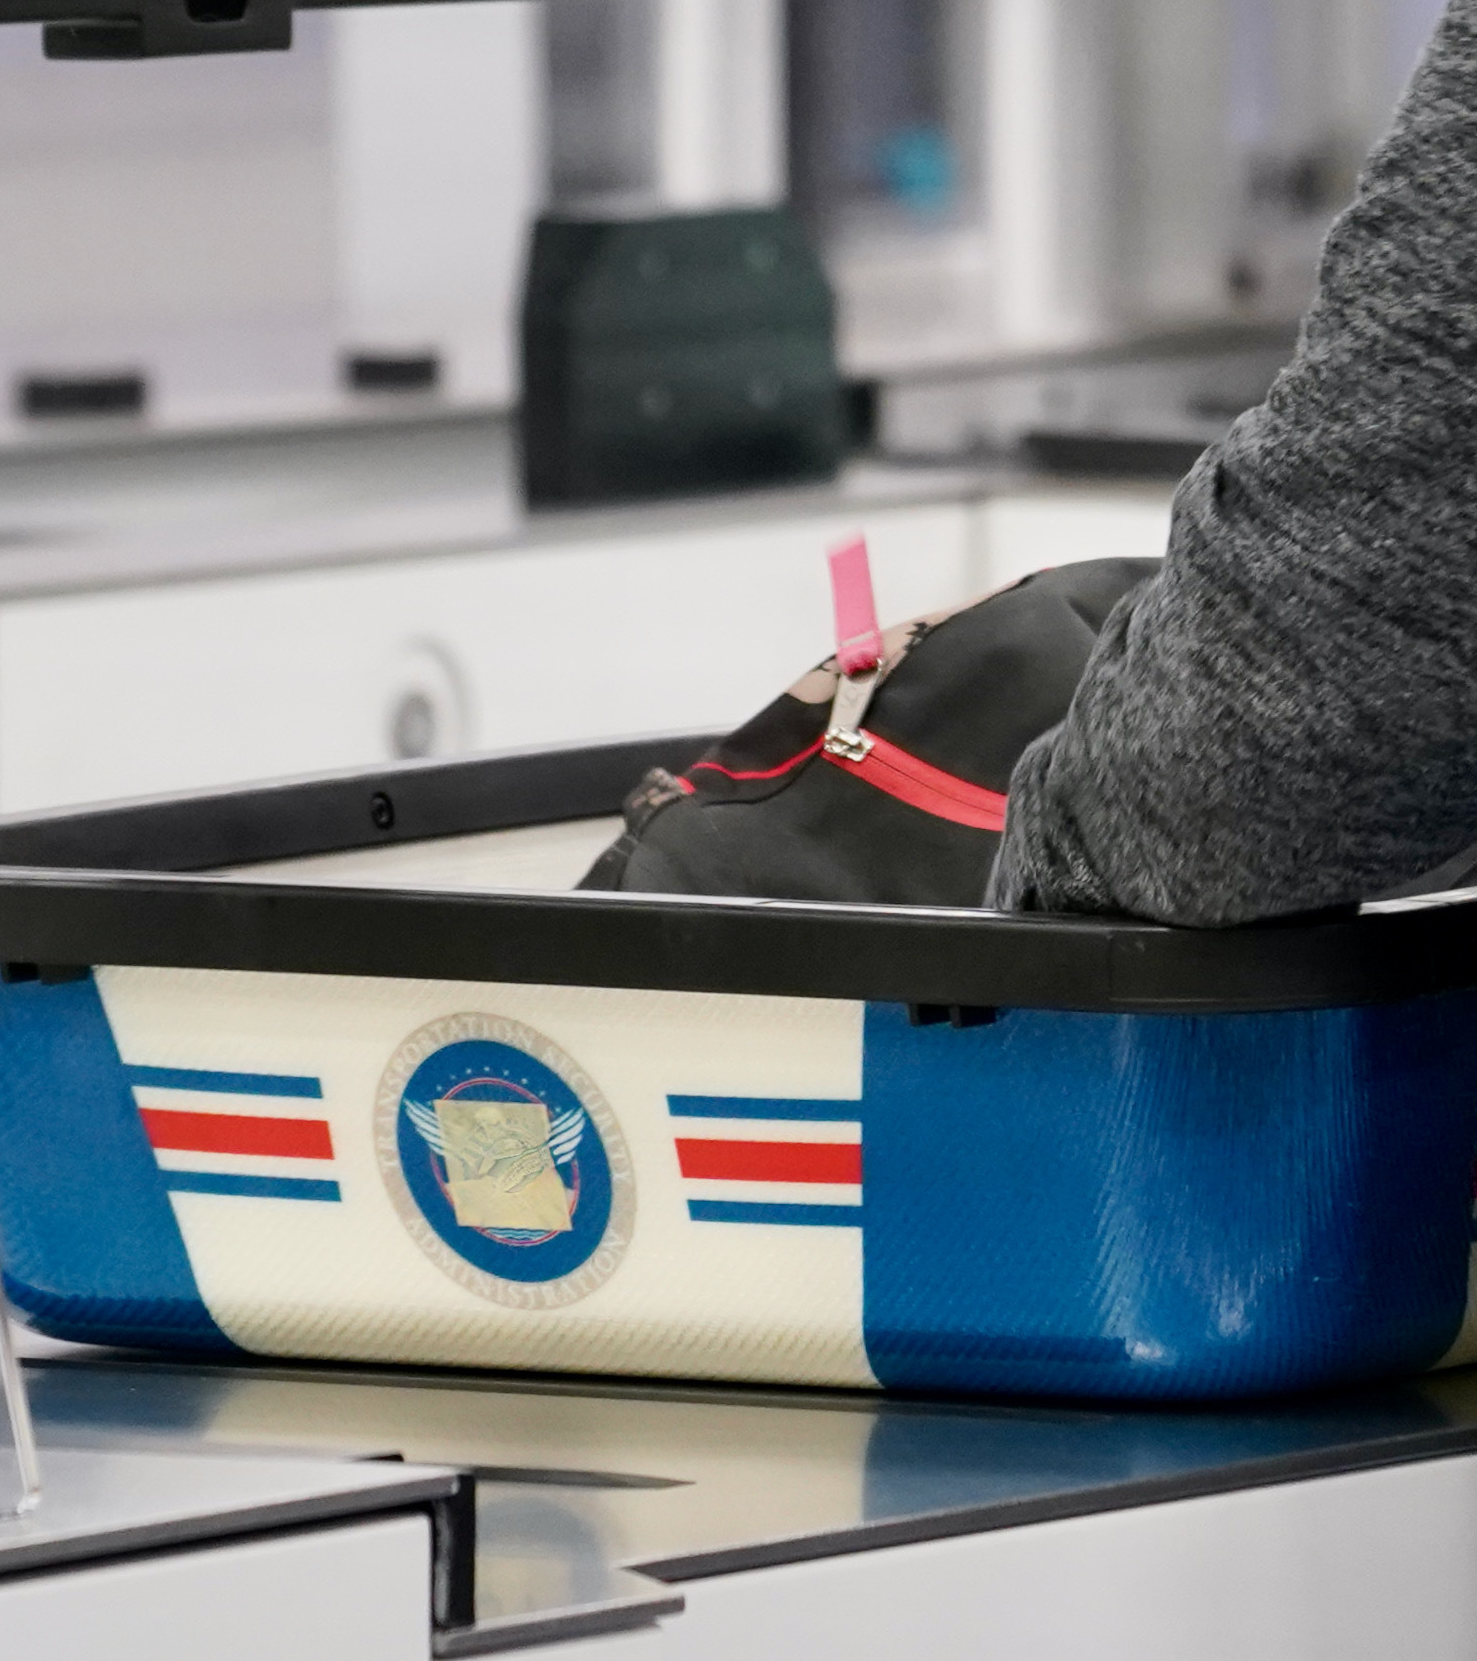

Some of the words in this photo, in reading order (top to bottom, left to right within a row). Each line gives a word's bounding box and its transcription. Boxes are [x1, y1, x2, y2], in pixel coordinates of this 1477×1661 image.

[376, 1014, 535, 1168] TRANSPORTATION
[542, 1047, 632, 1182] SECURITY
[408, 1218, 626, 1309] ADMINISTRATION
